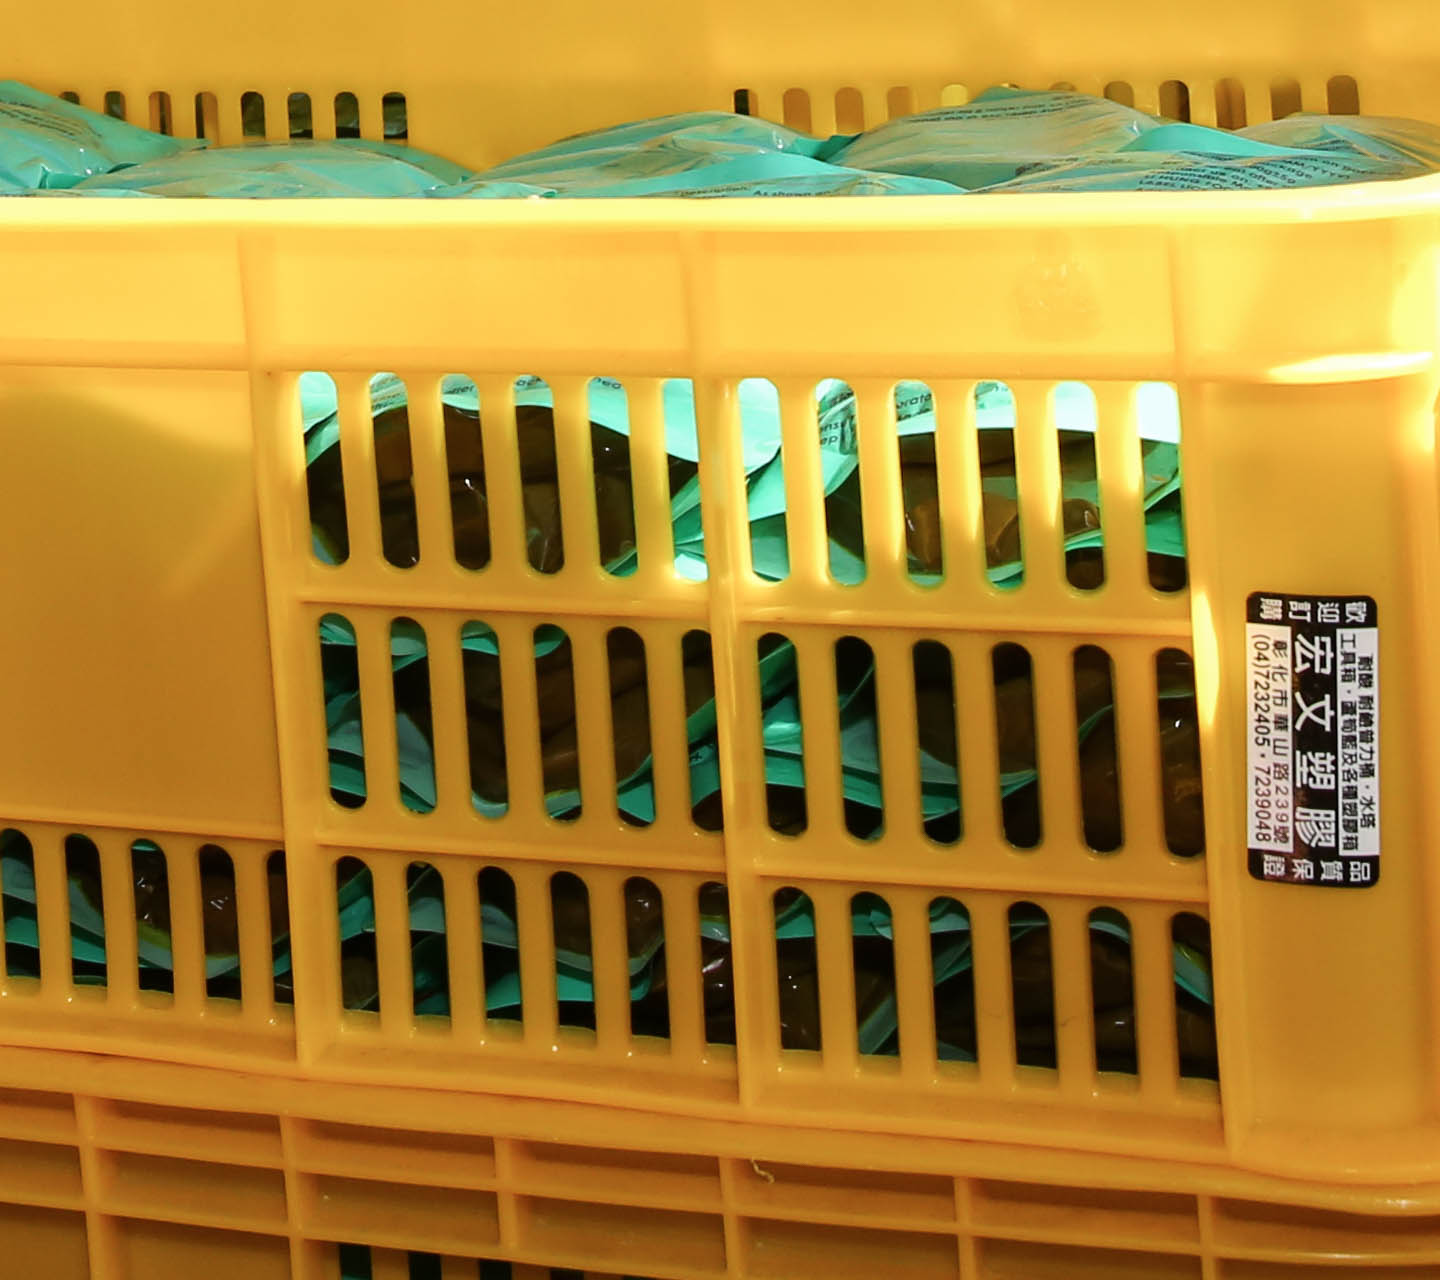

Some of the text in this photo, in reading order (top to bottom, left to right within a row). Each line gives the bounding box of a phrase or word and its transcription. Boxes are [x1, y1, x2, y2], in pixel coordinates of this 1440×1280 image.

[1259, 597, 1368, 624] 歡迎訂購
[1294, 633, 1337, 849] 宏文塑膠
[1262, 854, 1371, 884] 品質保證
